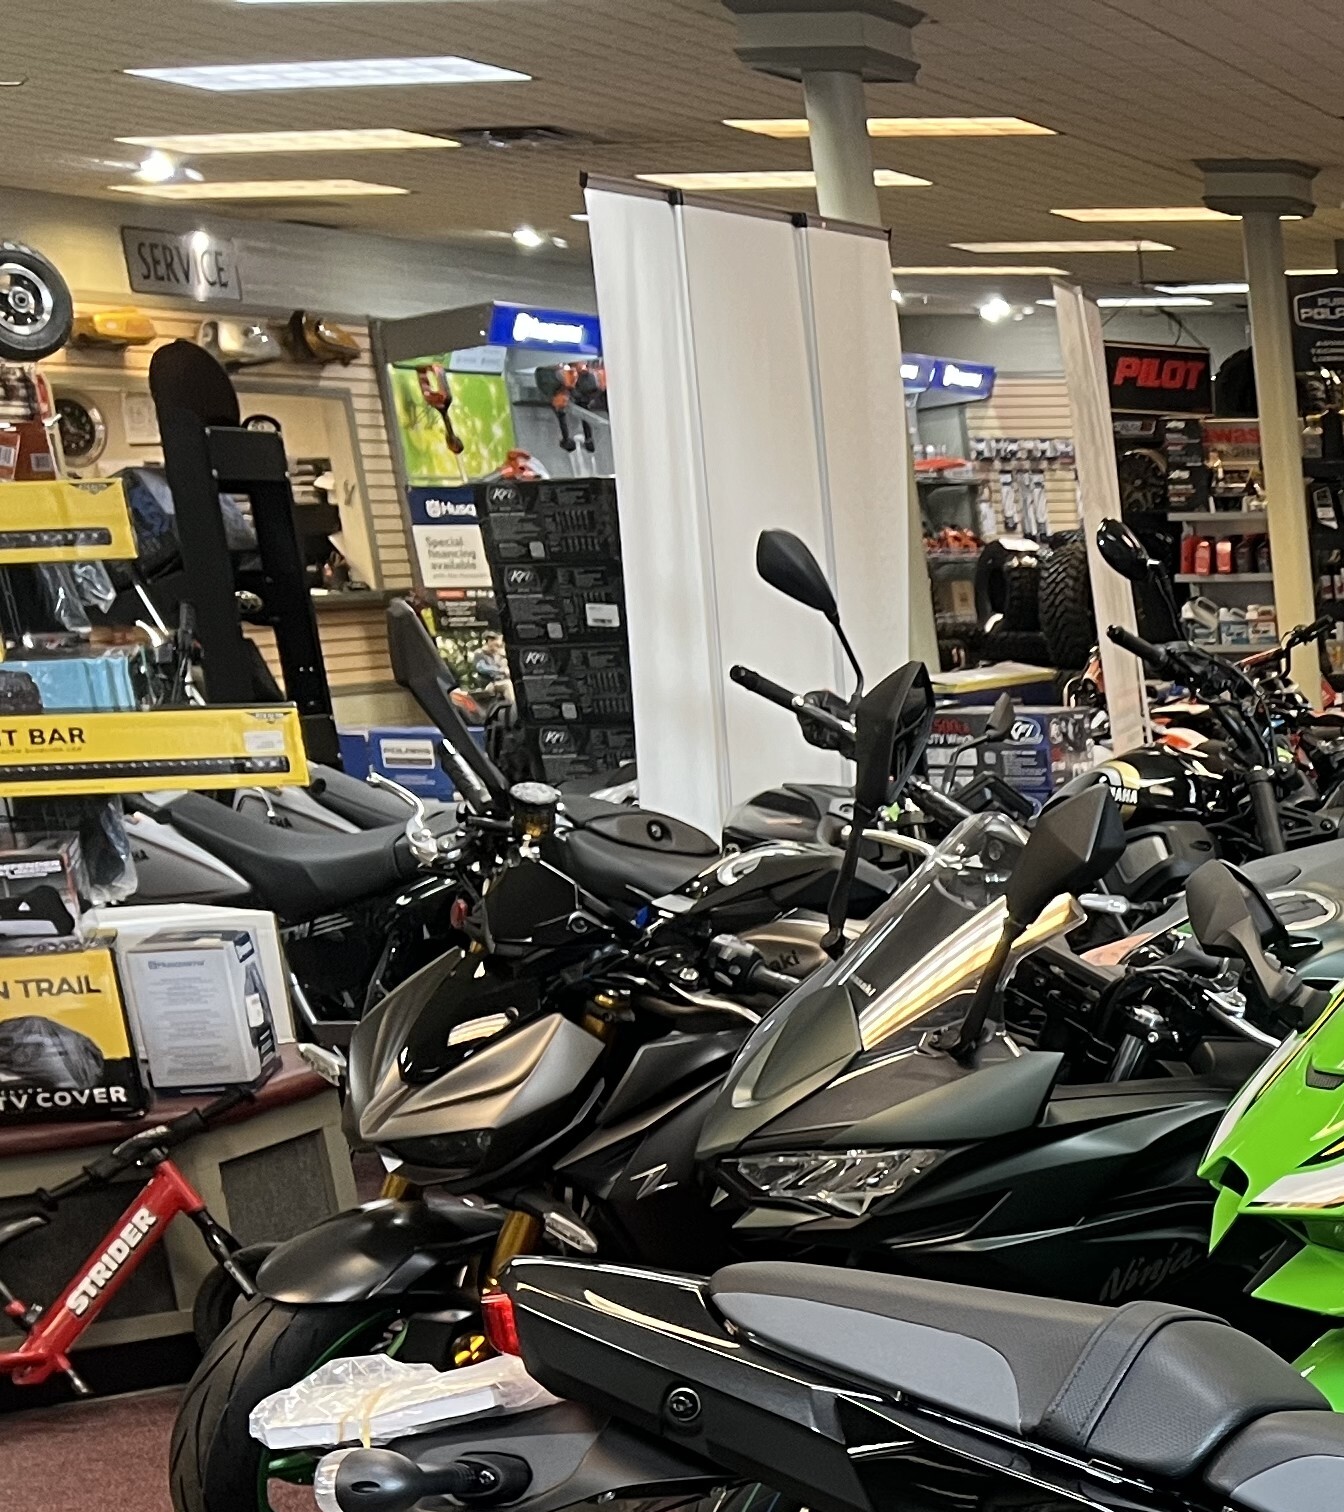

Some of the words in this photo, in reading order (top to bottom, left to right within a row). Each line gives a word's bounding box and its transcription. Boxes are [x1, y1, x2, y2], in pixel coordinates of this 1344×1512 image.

[137, 242, 229, 287] SERVICE
[1113, 356, 1206, 390] PILOT
[28, 727, 86, 746] BAR
[14, 975, 102, 998] TRAIL
[36, 1086, 128, 1108] COVER
[66, 1207, 157, 1316] STRIDER
[1099, 1242, 1202, 1302] Ninja
